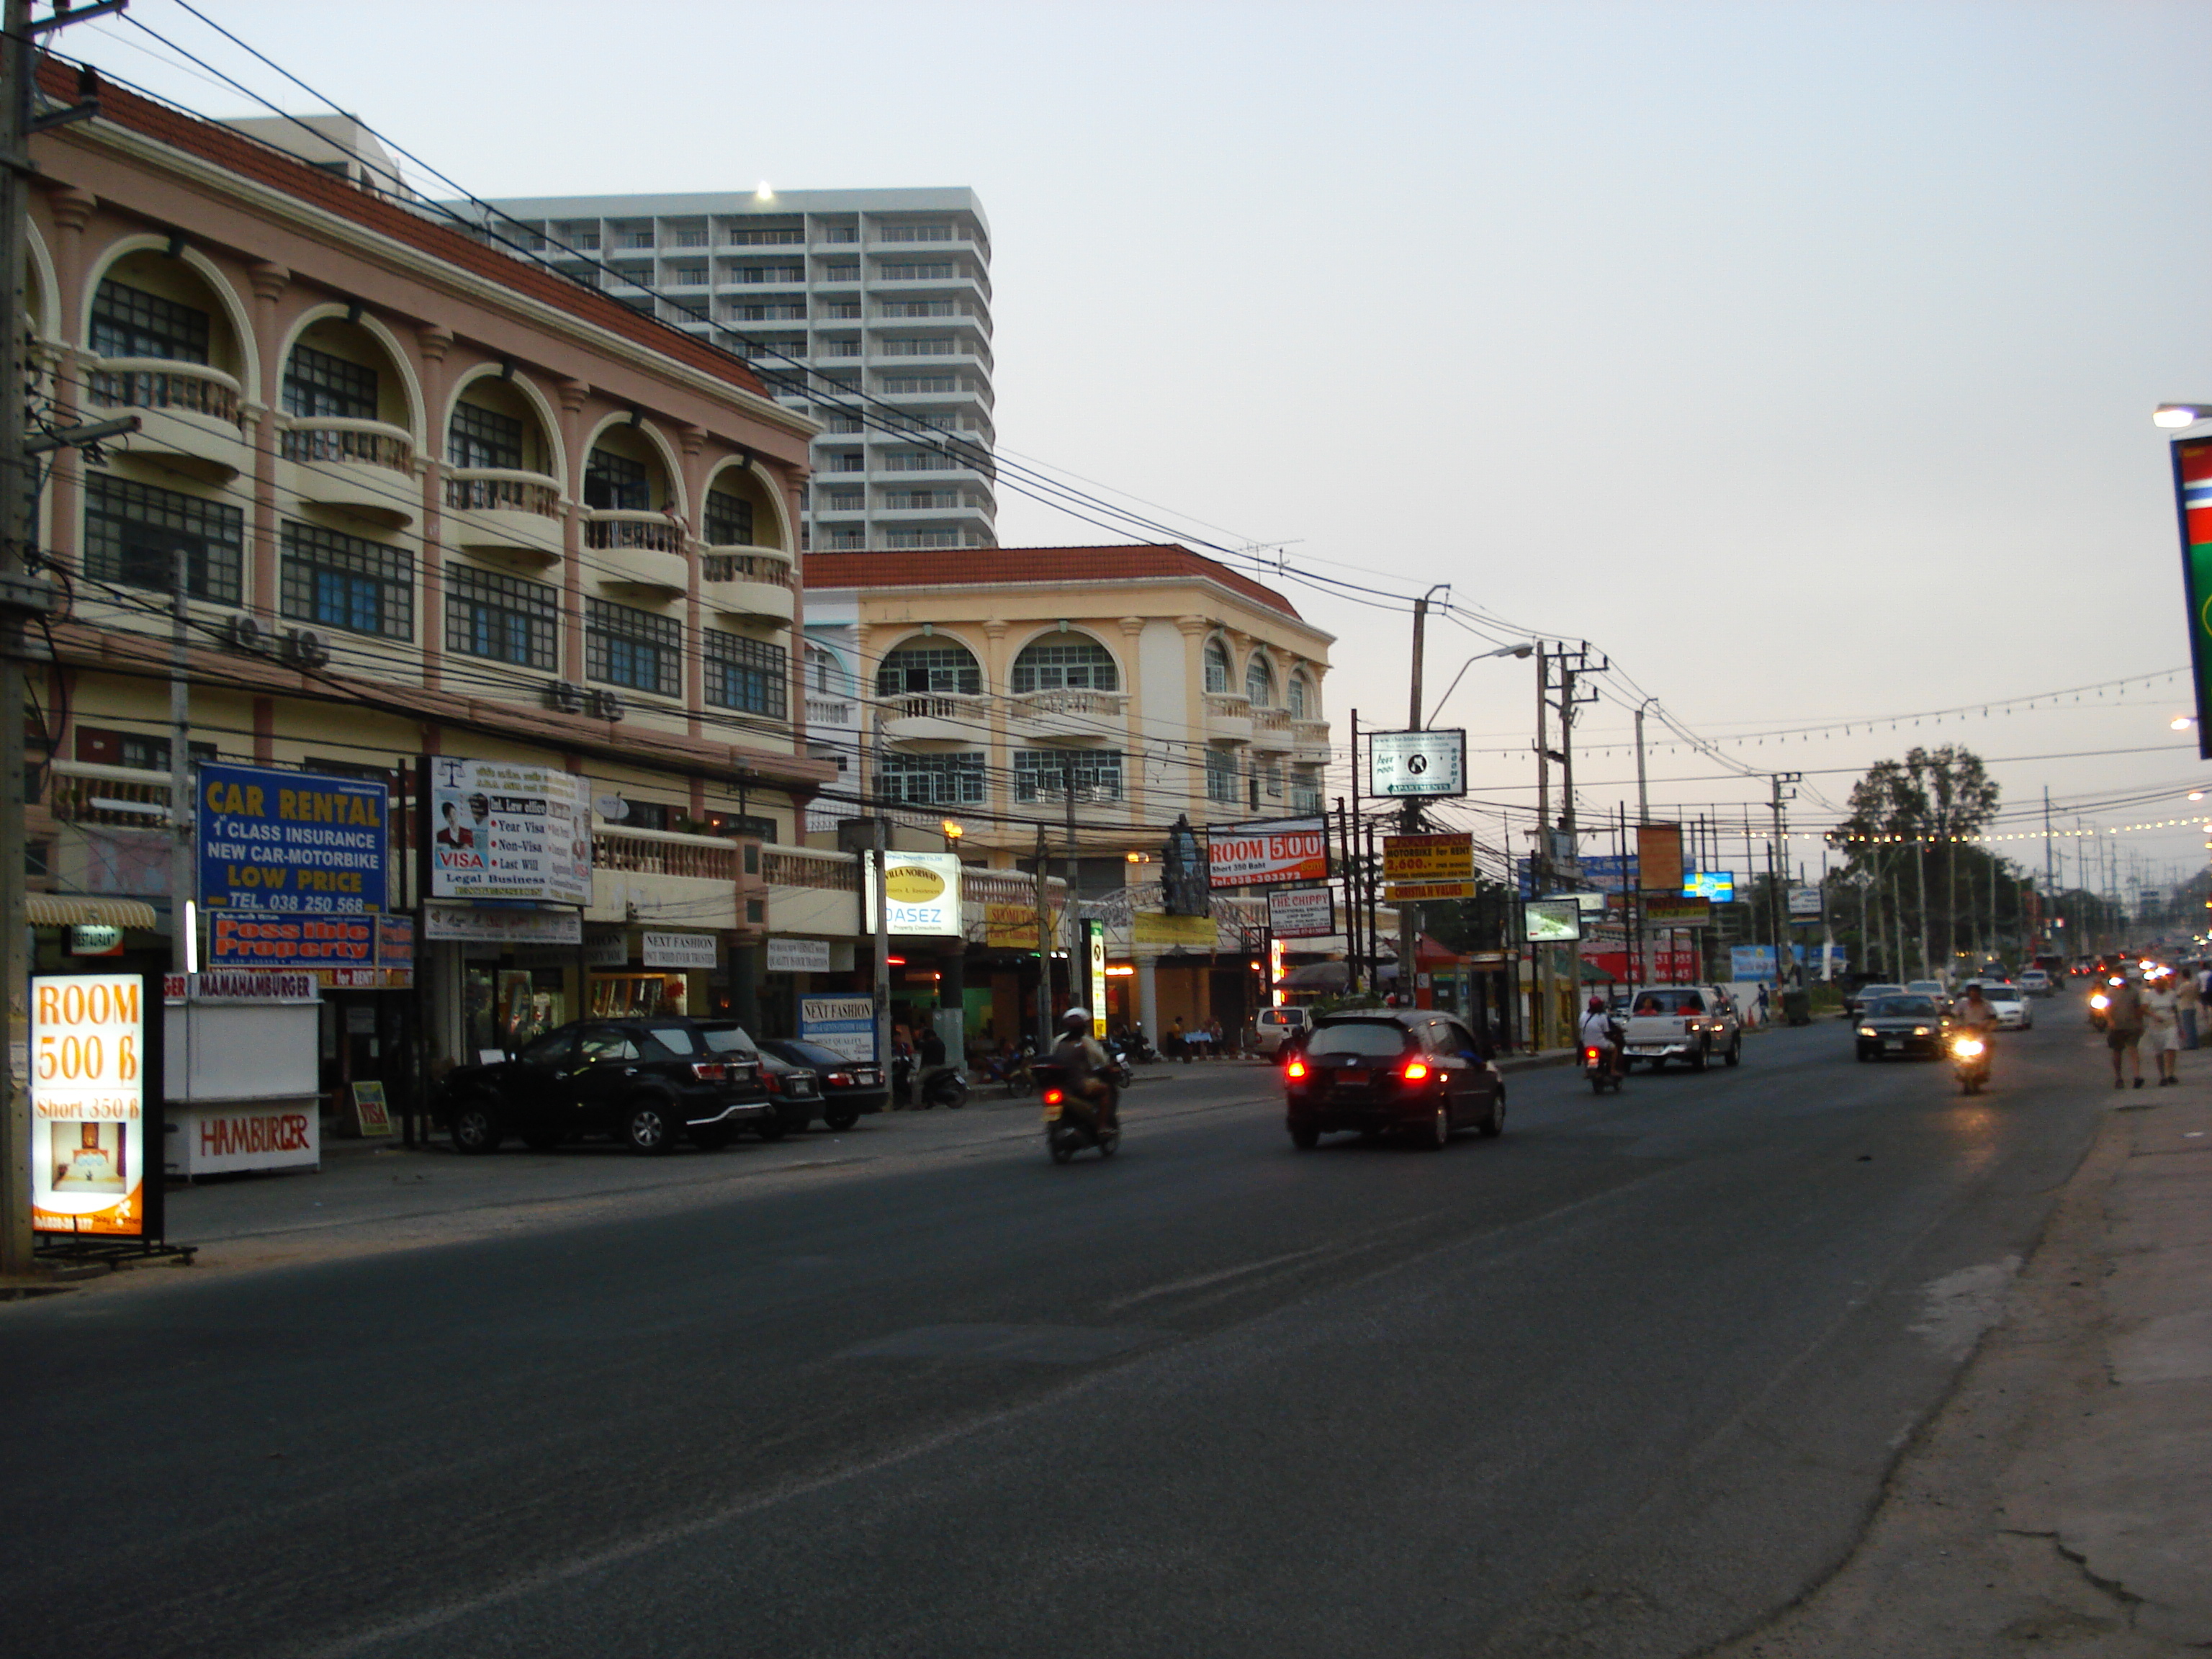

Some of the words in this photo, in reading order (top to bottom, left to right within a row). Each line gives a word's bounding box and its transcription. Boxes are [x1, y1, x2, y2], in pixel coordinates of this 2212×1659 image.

[206, 781, 265, 817] CAR
[279, 788, 380, 827] RENTAL
[228, 822, 281, 841] CLASS
[286, 827, 375, 850] INSURANCE
[498, 819, 520, 832] Year
[524, 821, 545, 834] Visa
[207, 842, 246, 860] NEW
[251, 845, 379, 869] CAR-MOTORBIKE
[498, 839, 543, 853] Non-Visa
[1210, 840, 1264, 864] ROOM
[1272, 835, 1319, 858] 500
[1386, 848, 1432, 858] MOTORBIKE
[1450, 846, 1470, 855] RENT
[439, 853, 485, 868] VISA
[500, 858, 518, 870] Last
[521, 859, 539, 871] Will
[228, 865, 287, 889] LOW
[297, 869, 362, 893] PRICE
[446, 873, 482, 884] Legal
[489, 874, 545, 884] Business
[905, 868, 938, 882] NORWAY
[230, 892, 264, 909] TEL.
[269, 895, 299, 911] 038
[305, 896, 333, 912] 250
[337, 897, 364, 914] 568
[1271, 896, 1290, 907] THE
[1292, 893, 1328, 907] CHIPPY
[216, 920, 370, 940] Possible
[216, 938, 369, 959] Property
[647, 936, 671, 948] NEXT
[673, 936, 714, 948] FASHION
[199, 974, 310, 997] MAMAHAMBURGER
[337, 969, 351, 985] for
[352, 969, 374, 986] RENT
[39, 983, 138, 1025] ROOM
[805, 1004, 827, 1019] NEXT
[831, 1003, 870, 1018] FASHION
[38, 1035, 104, 1080] 500
[37, 1097, 83, 1119] Short
[89, 1097, 123, 1119] 350
[201, 1114, 310, 1156] HAMBURGER
